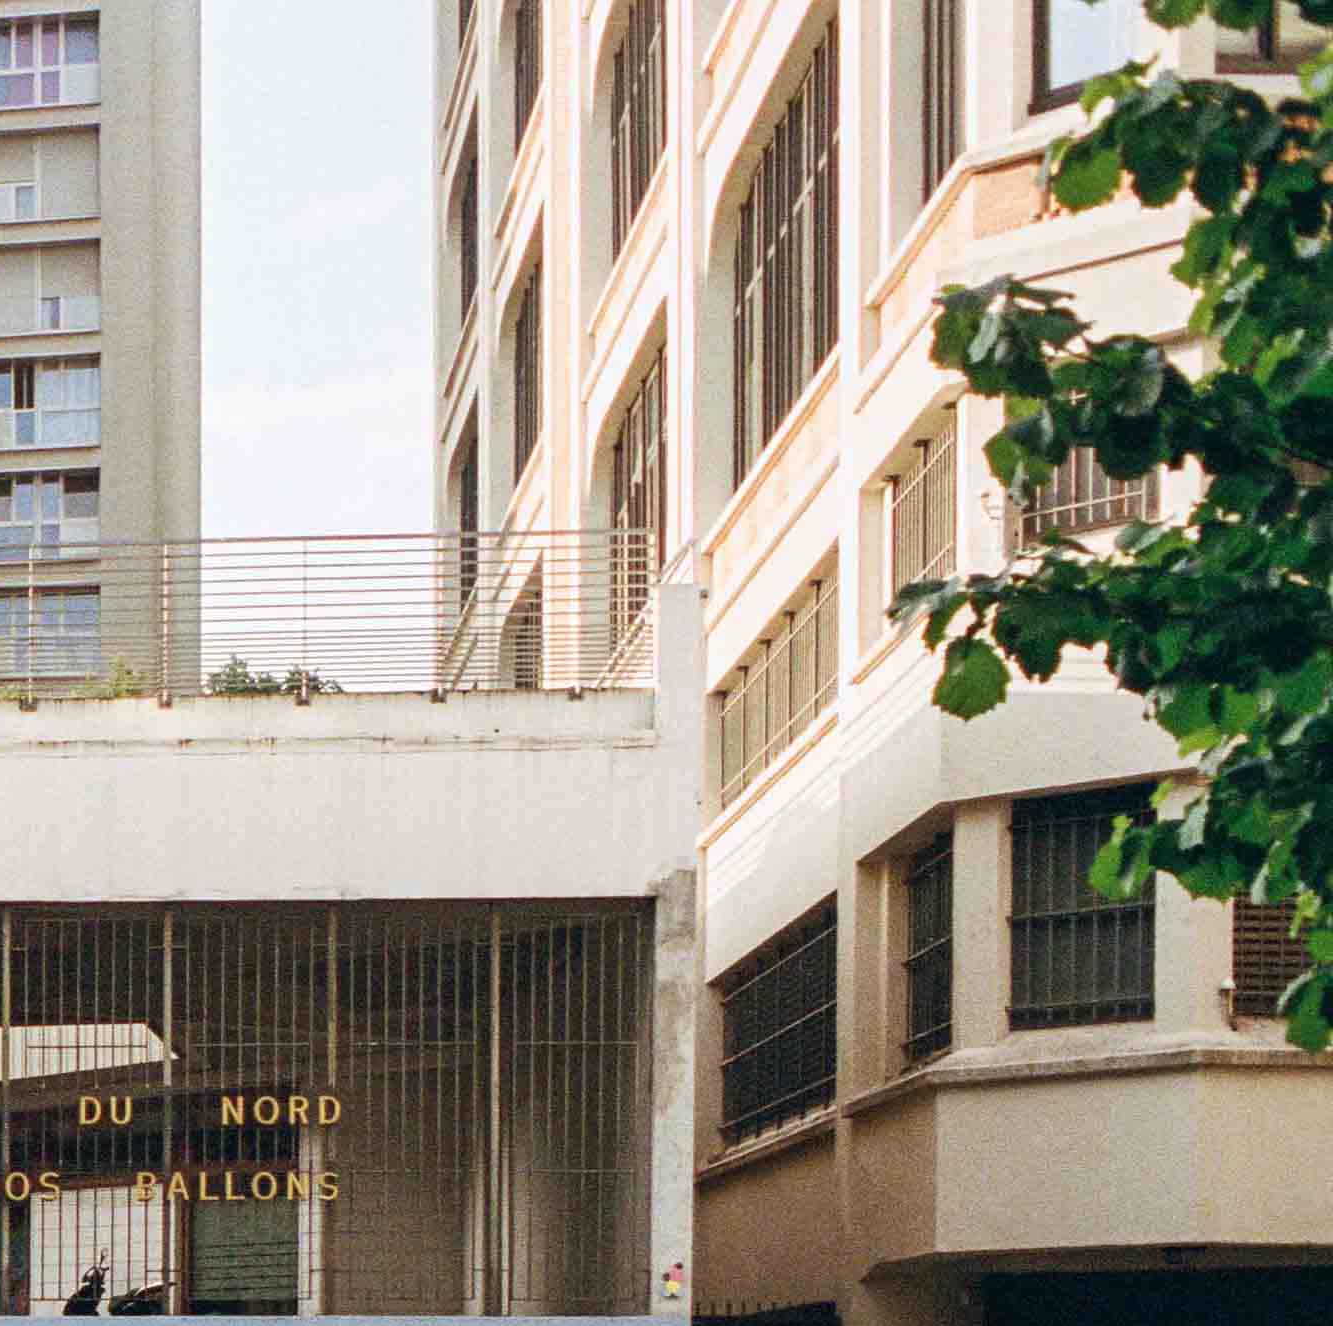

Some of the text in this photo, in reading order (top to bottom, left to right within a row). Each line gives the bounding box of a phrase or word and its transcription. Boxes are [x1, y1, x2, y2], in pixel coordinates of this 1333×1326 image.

[78, 1095, 133, 1126] DU
[221, 1095, 343, 1126] NORD
[136, 1171, 341, 1202] BALLONS
